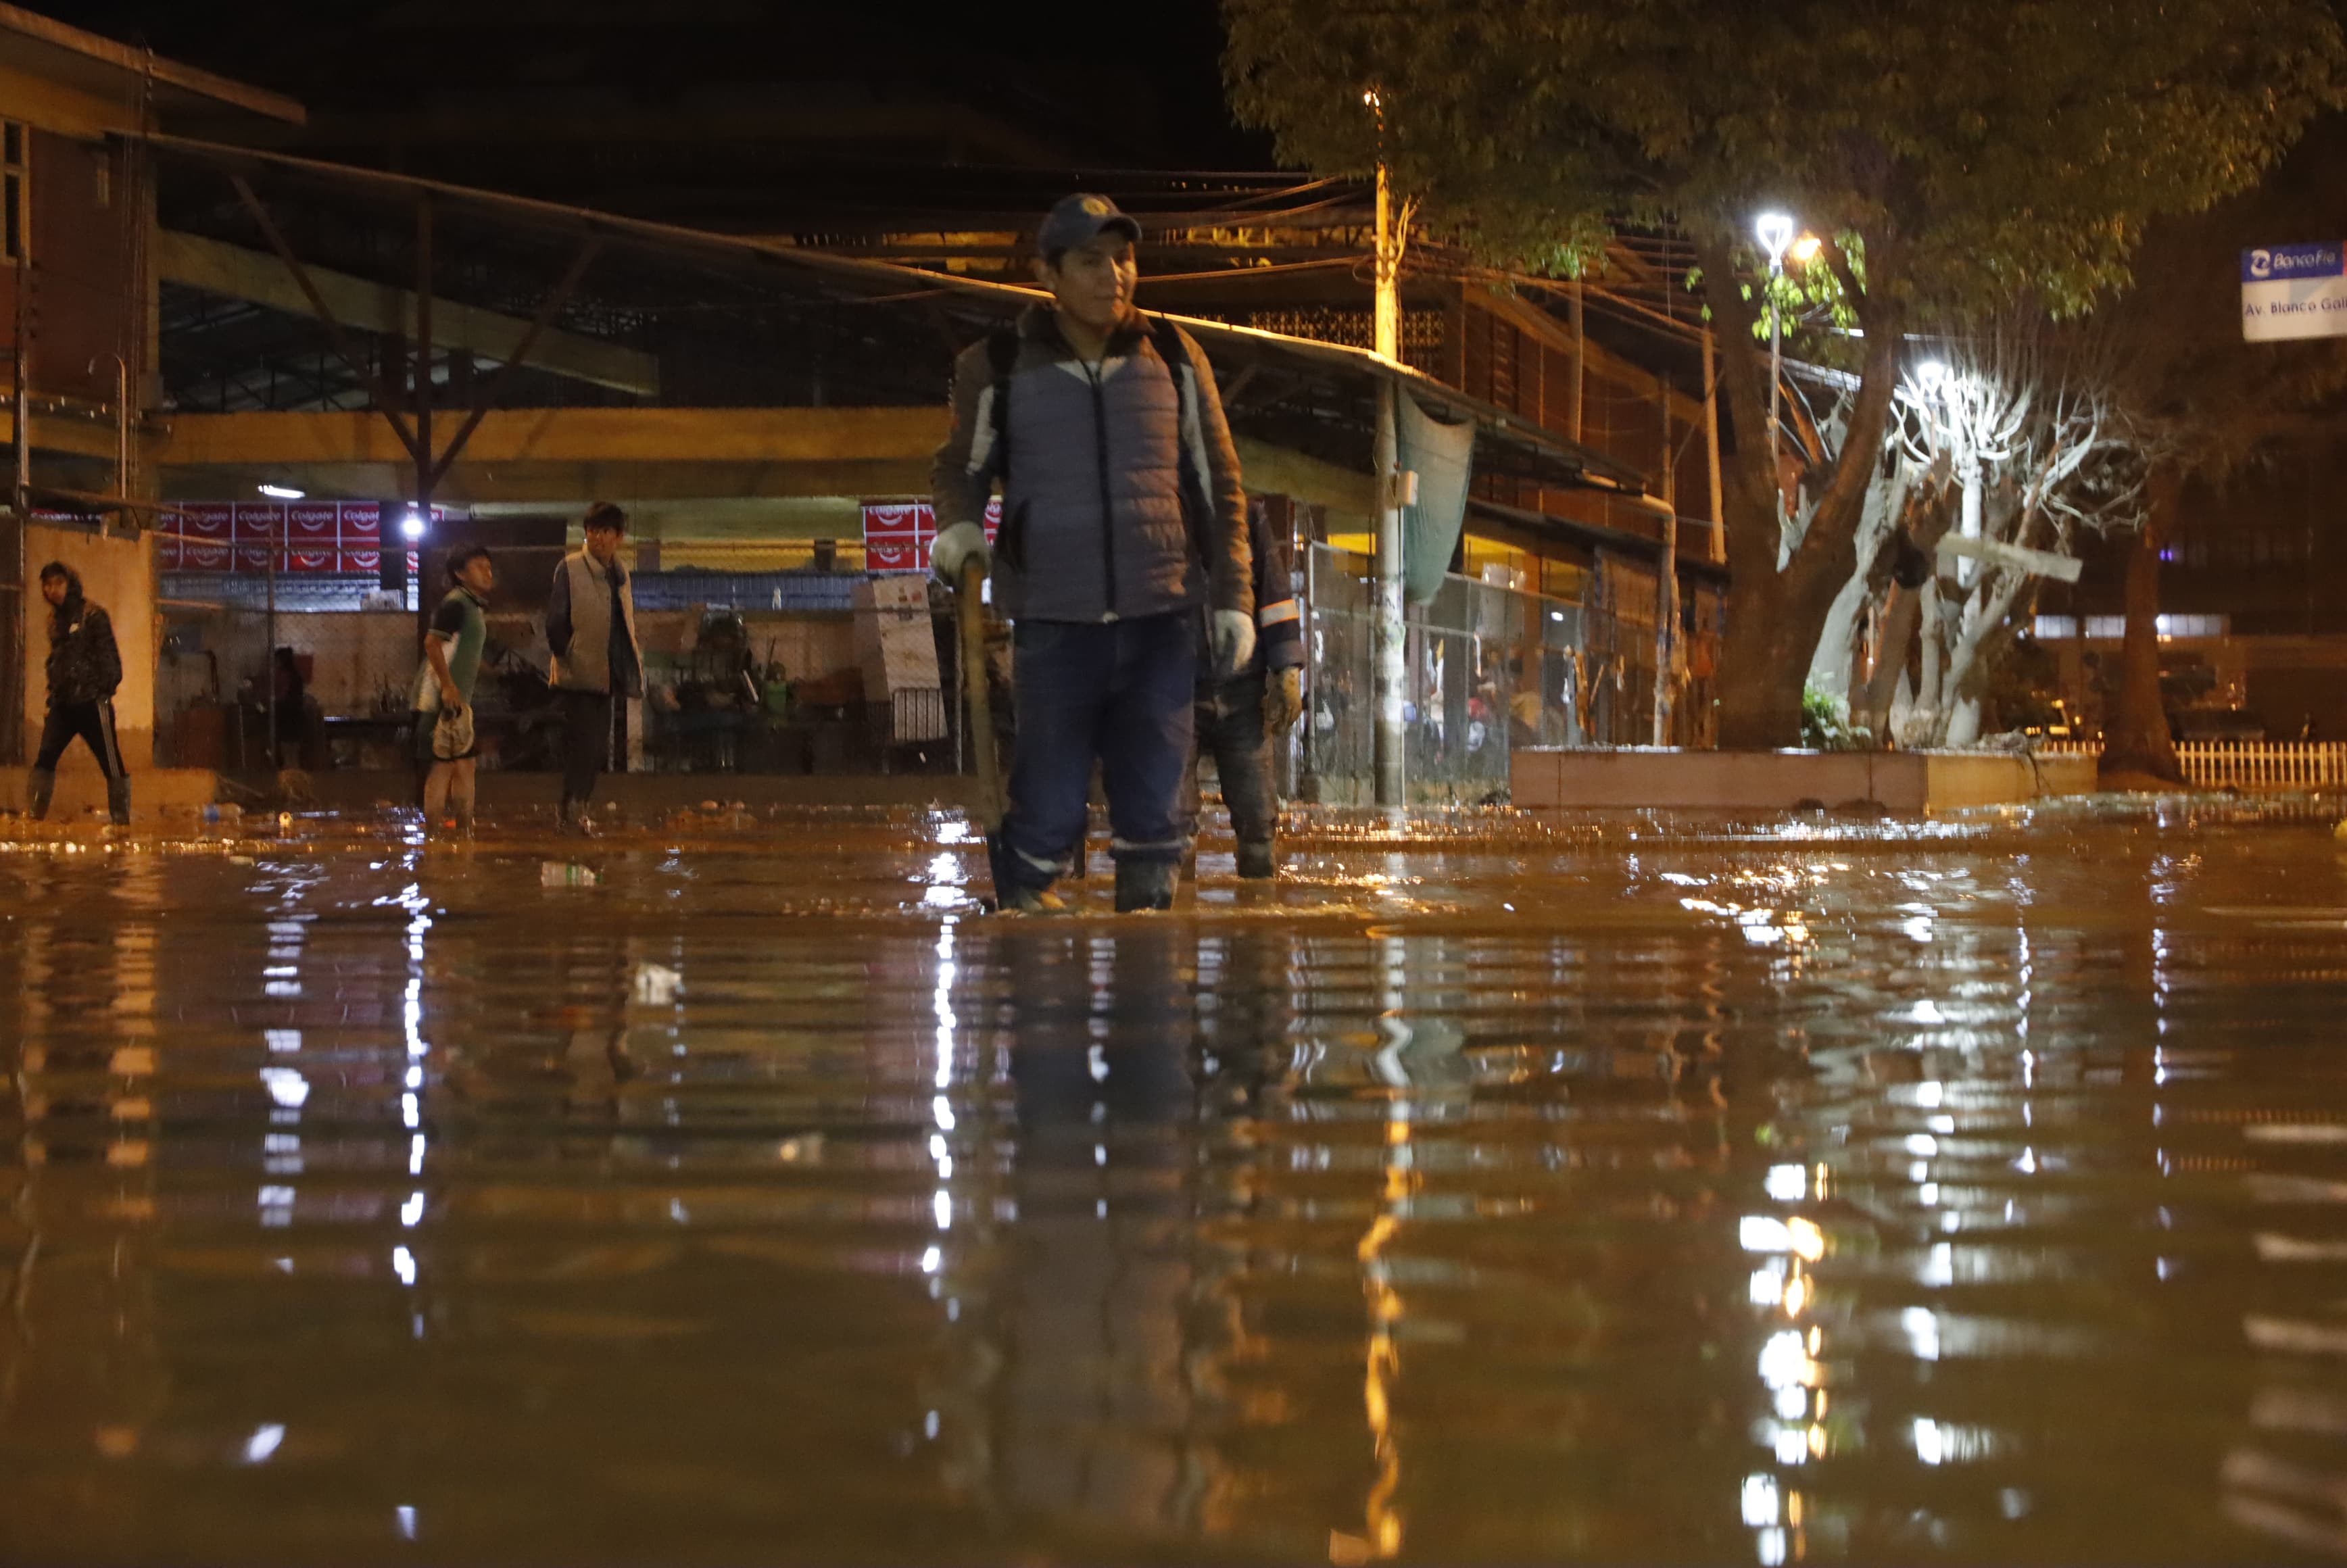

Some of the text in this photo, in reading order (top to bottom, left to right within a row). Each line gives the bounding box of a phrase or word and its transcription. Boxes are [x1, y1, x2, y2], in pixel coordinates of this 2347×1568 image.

[2271, 301, 2317, 314] Blanco
[239, 511, 281, 522] Colgate
[291, 510, 333, 522] Colgate
[343, 510, 379, 522] Colgat
